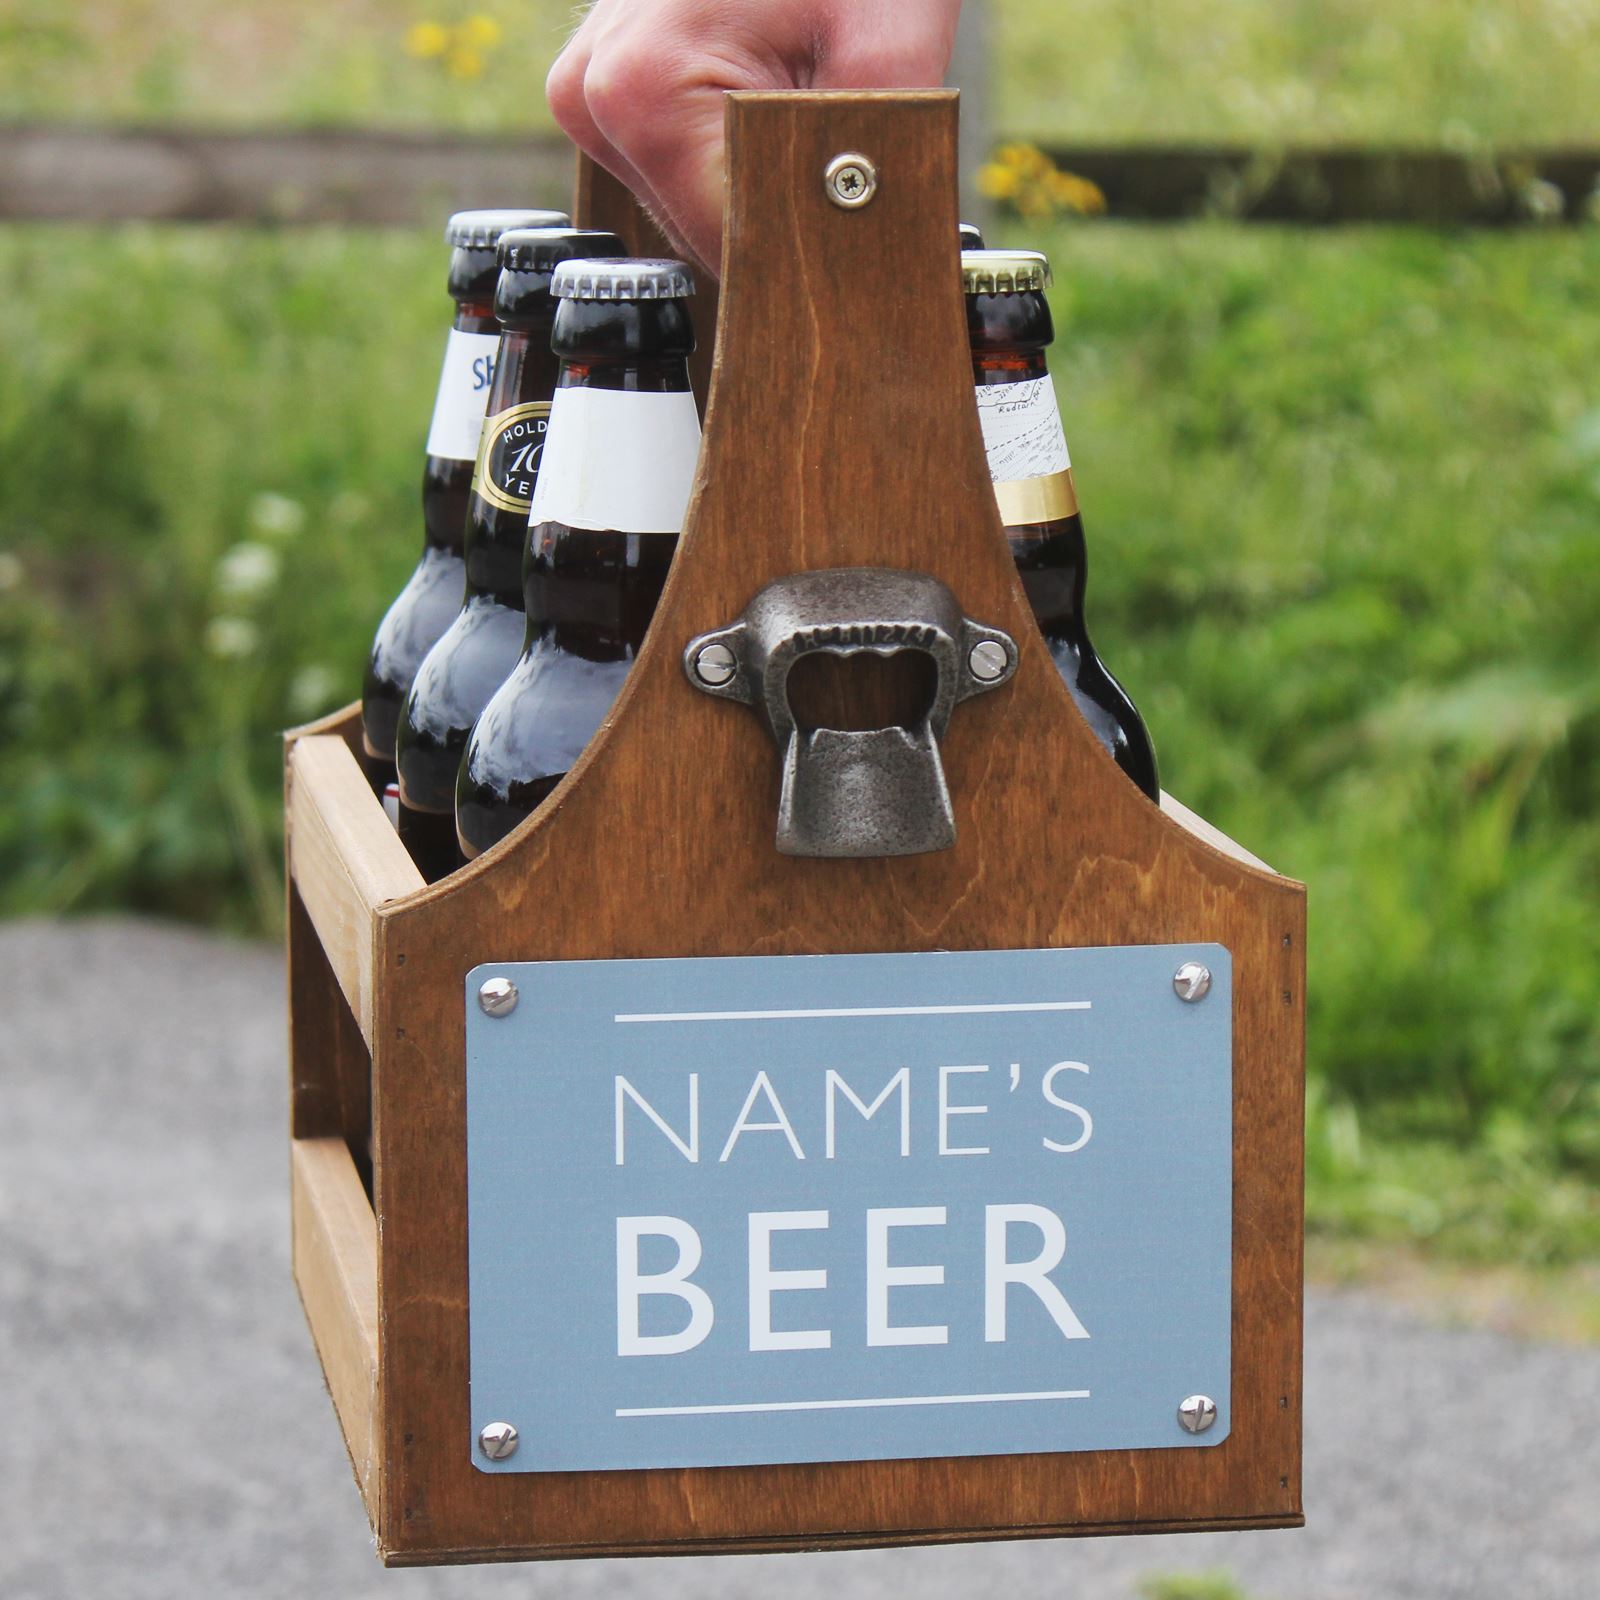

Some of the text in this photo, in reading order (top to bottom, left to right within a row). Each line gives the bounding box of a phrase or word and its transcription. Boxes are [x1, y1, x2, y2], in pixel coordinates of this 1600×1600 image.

[502, 420, 548, 444] HOLD
[614, 1060, 1095, 1166] NAME'S
[615, 1203, 1091, 1356] BEER
